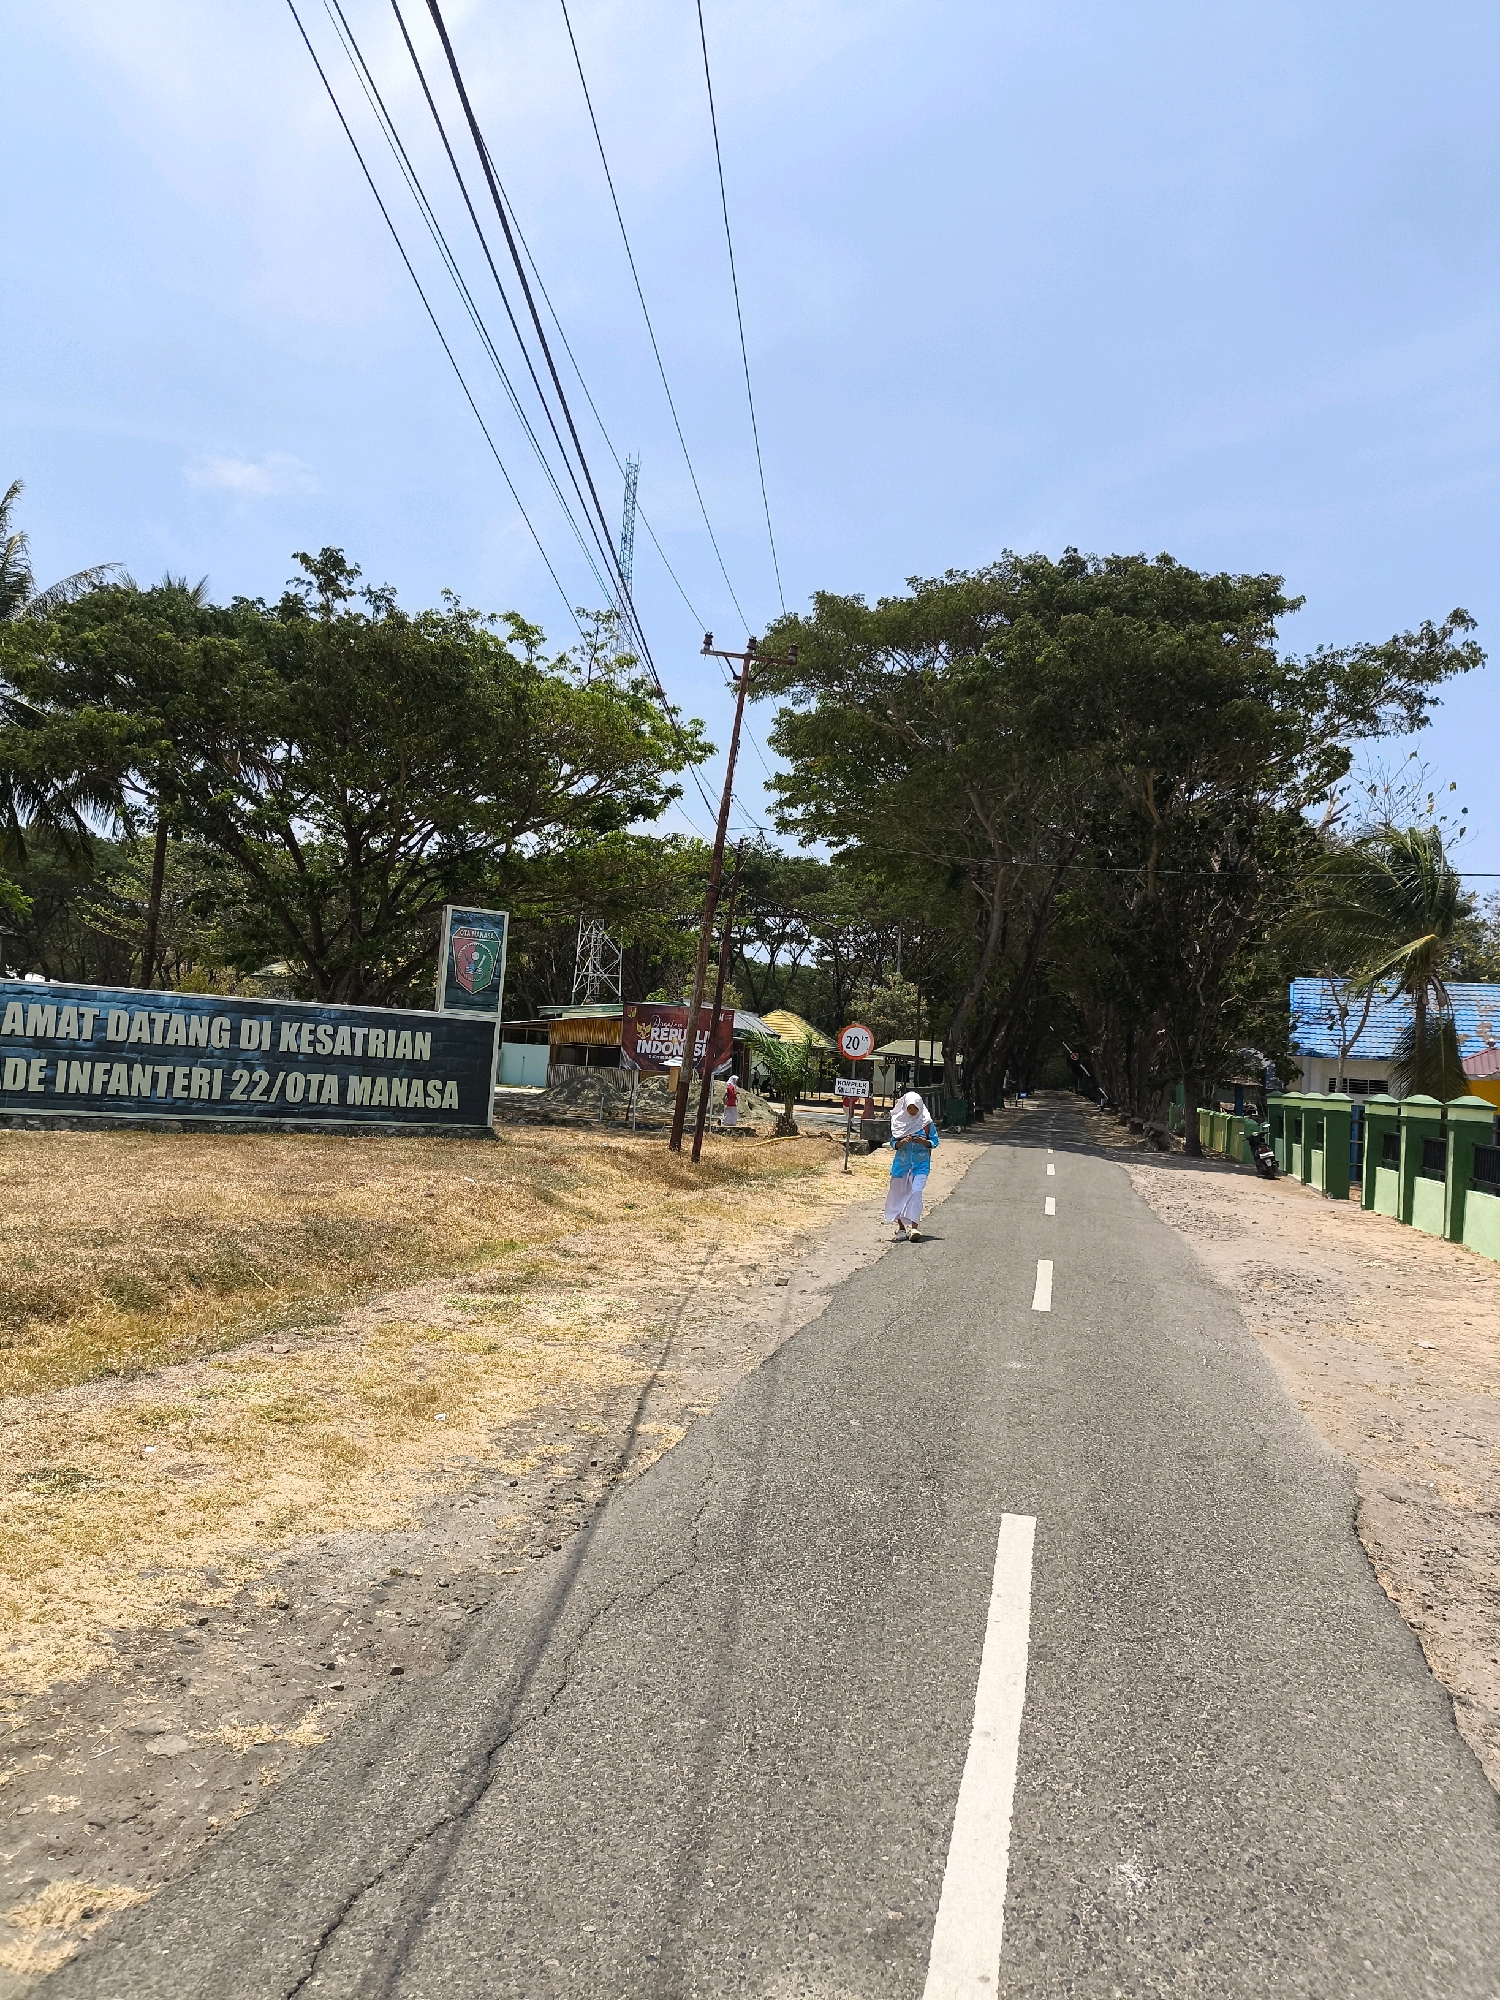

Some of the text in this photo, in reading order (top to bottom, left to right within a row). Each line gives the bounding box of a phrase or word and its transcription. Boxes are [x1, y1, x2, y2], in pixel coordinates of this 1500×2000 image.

[1, 1002, 432, 1061] AMAT DATANG DI KESATRIAN
[650, 1027, 711, 1044] REPULI
[636, 1040, 707, 1057] INDONSI
[846, 1035, 860, 1050] 20
[2, 1057, 460, 1110] DE INFANTERI 22/OTA MANASA
